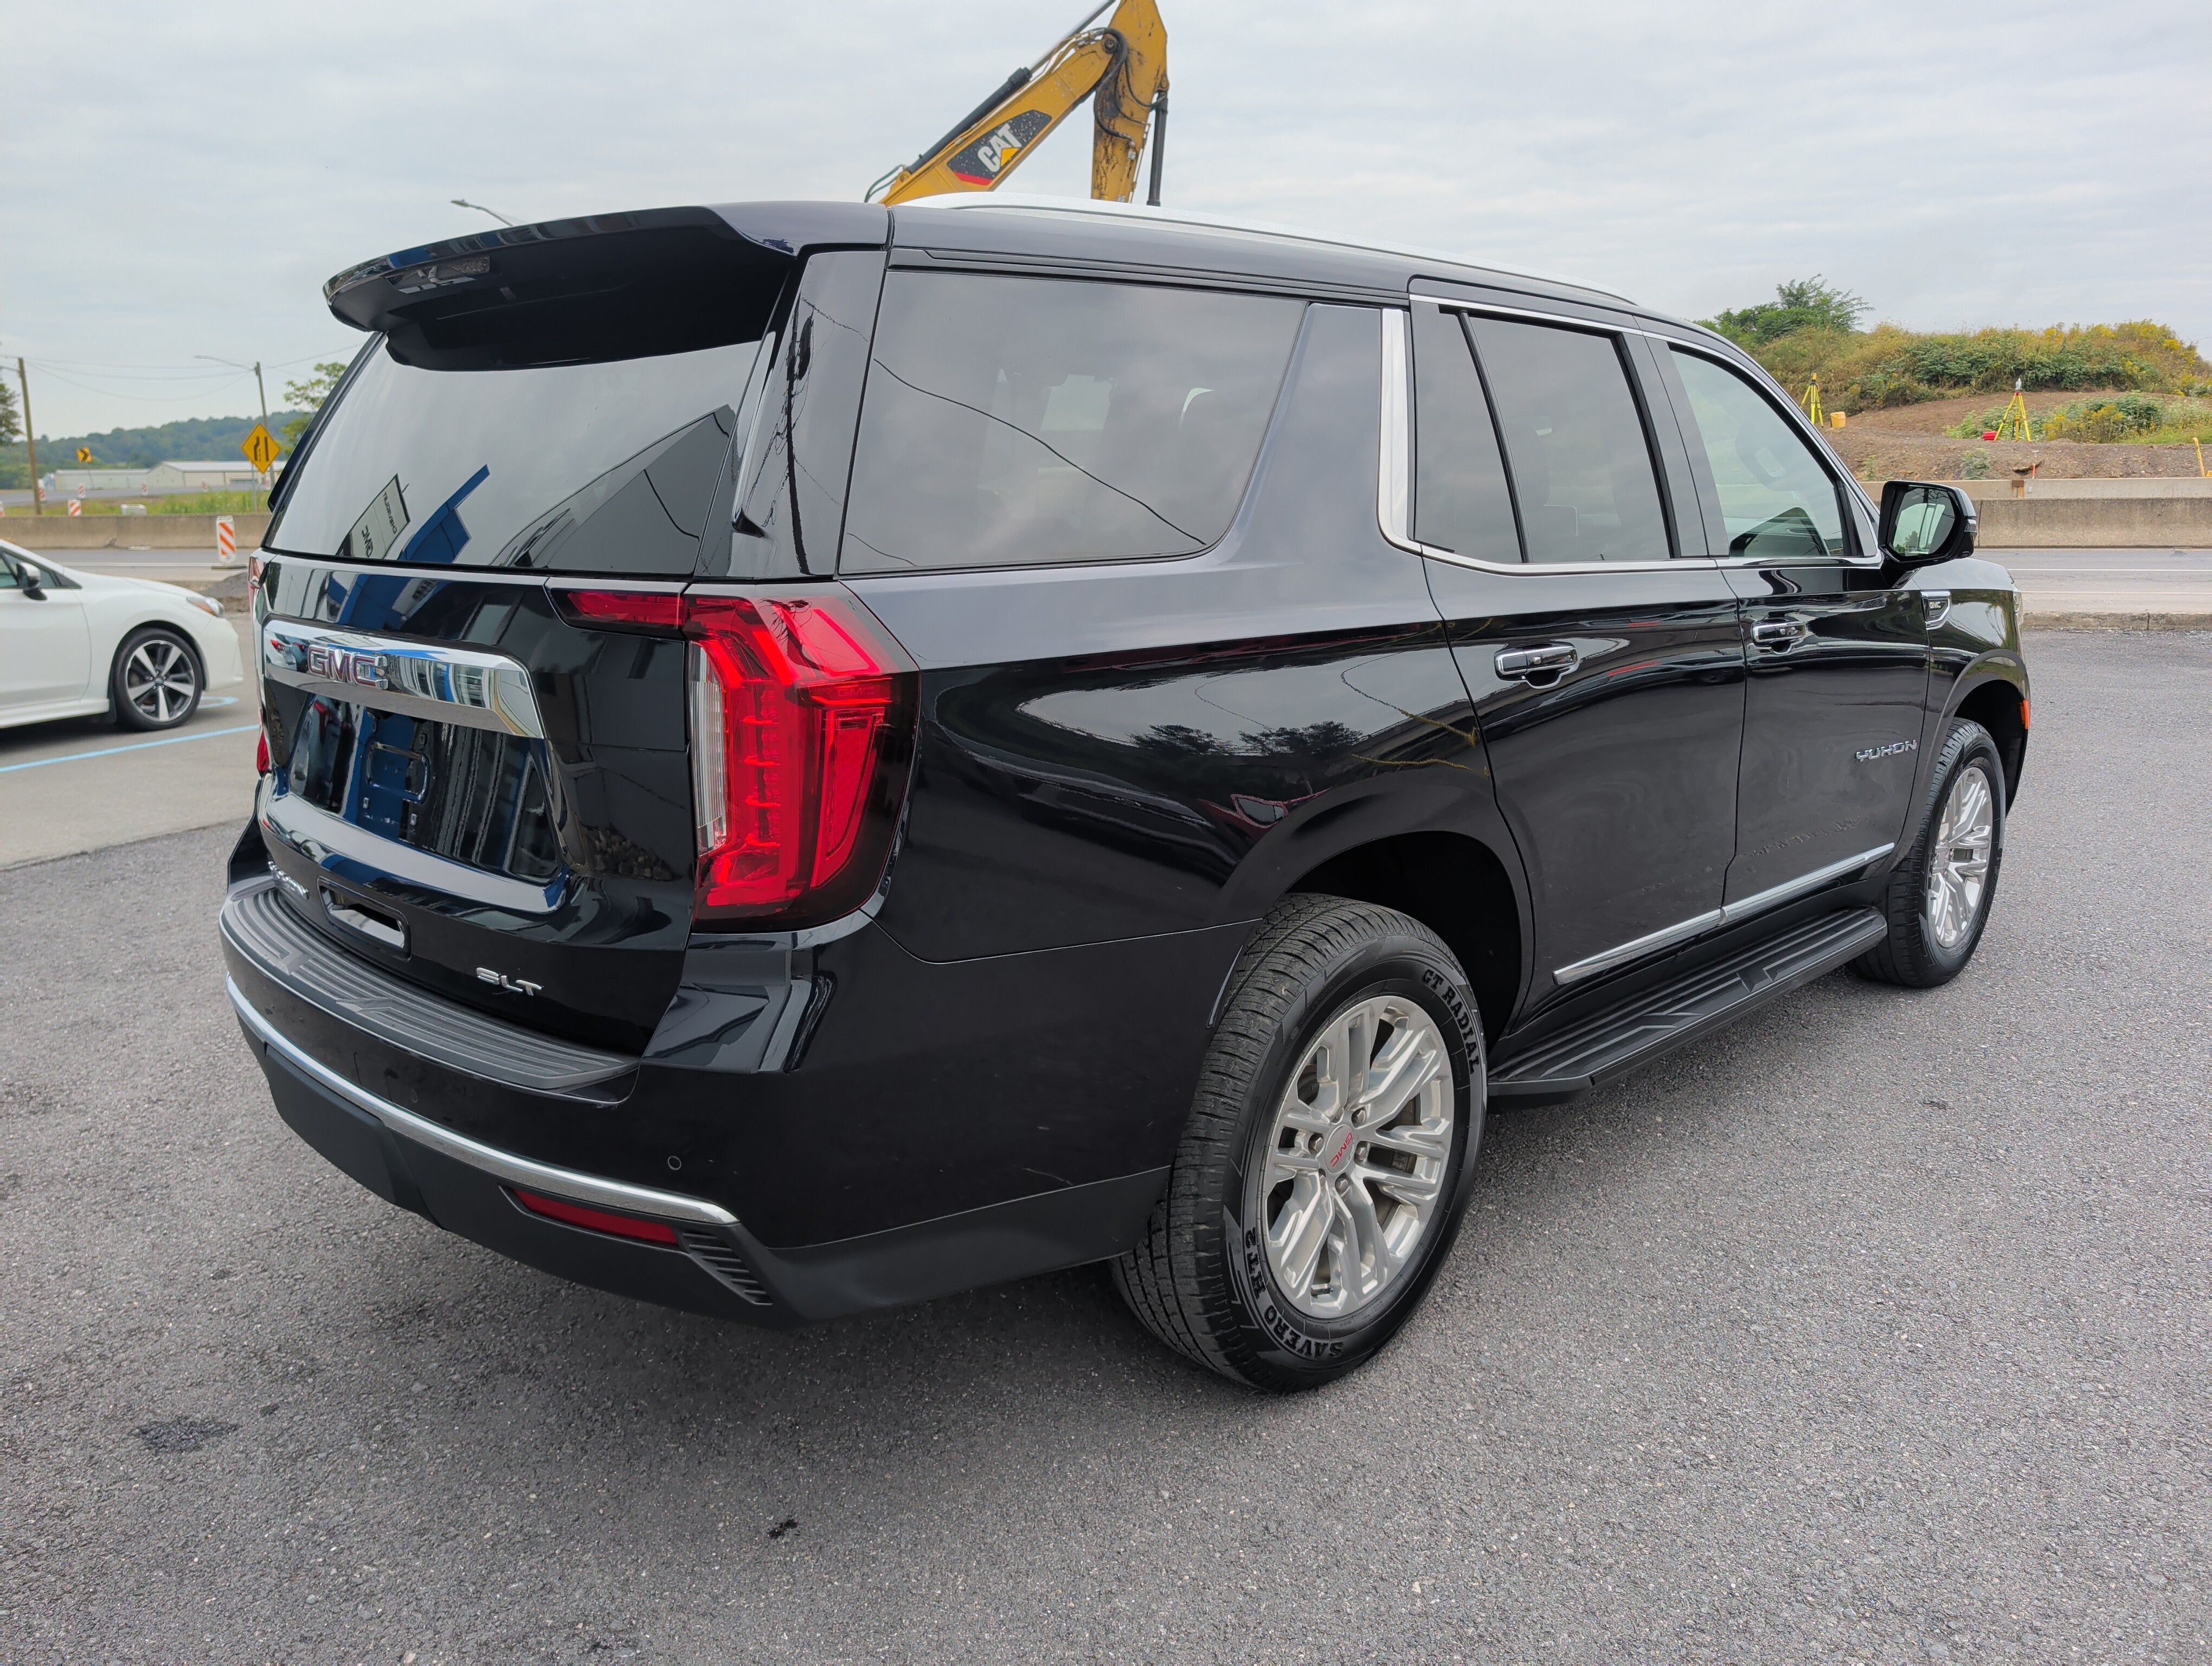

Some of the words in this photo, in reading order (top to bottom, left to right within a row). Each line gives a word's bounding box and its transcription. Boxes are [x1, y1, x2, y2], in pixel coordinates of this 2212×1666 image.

[978, 123, 1023, 172] CAT
[307, 644, 389, 691] GMC
[838, 685, 876, 697] GMC
[1856, 739, 1918, 762] YUKON
[476, 967, 542, 996] SLT
[1422, 969, 1444, 991] GT
[1442, 985, 1480, 1074] RADIAL
[1330, 1131, 1353, 1168] GMC
[1264, 1304, 1344, 1359] SAVERO
